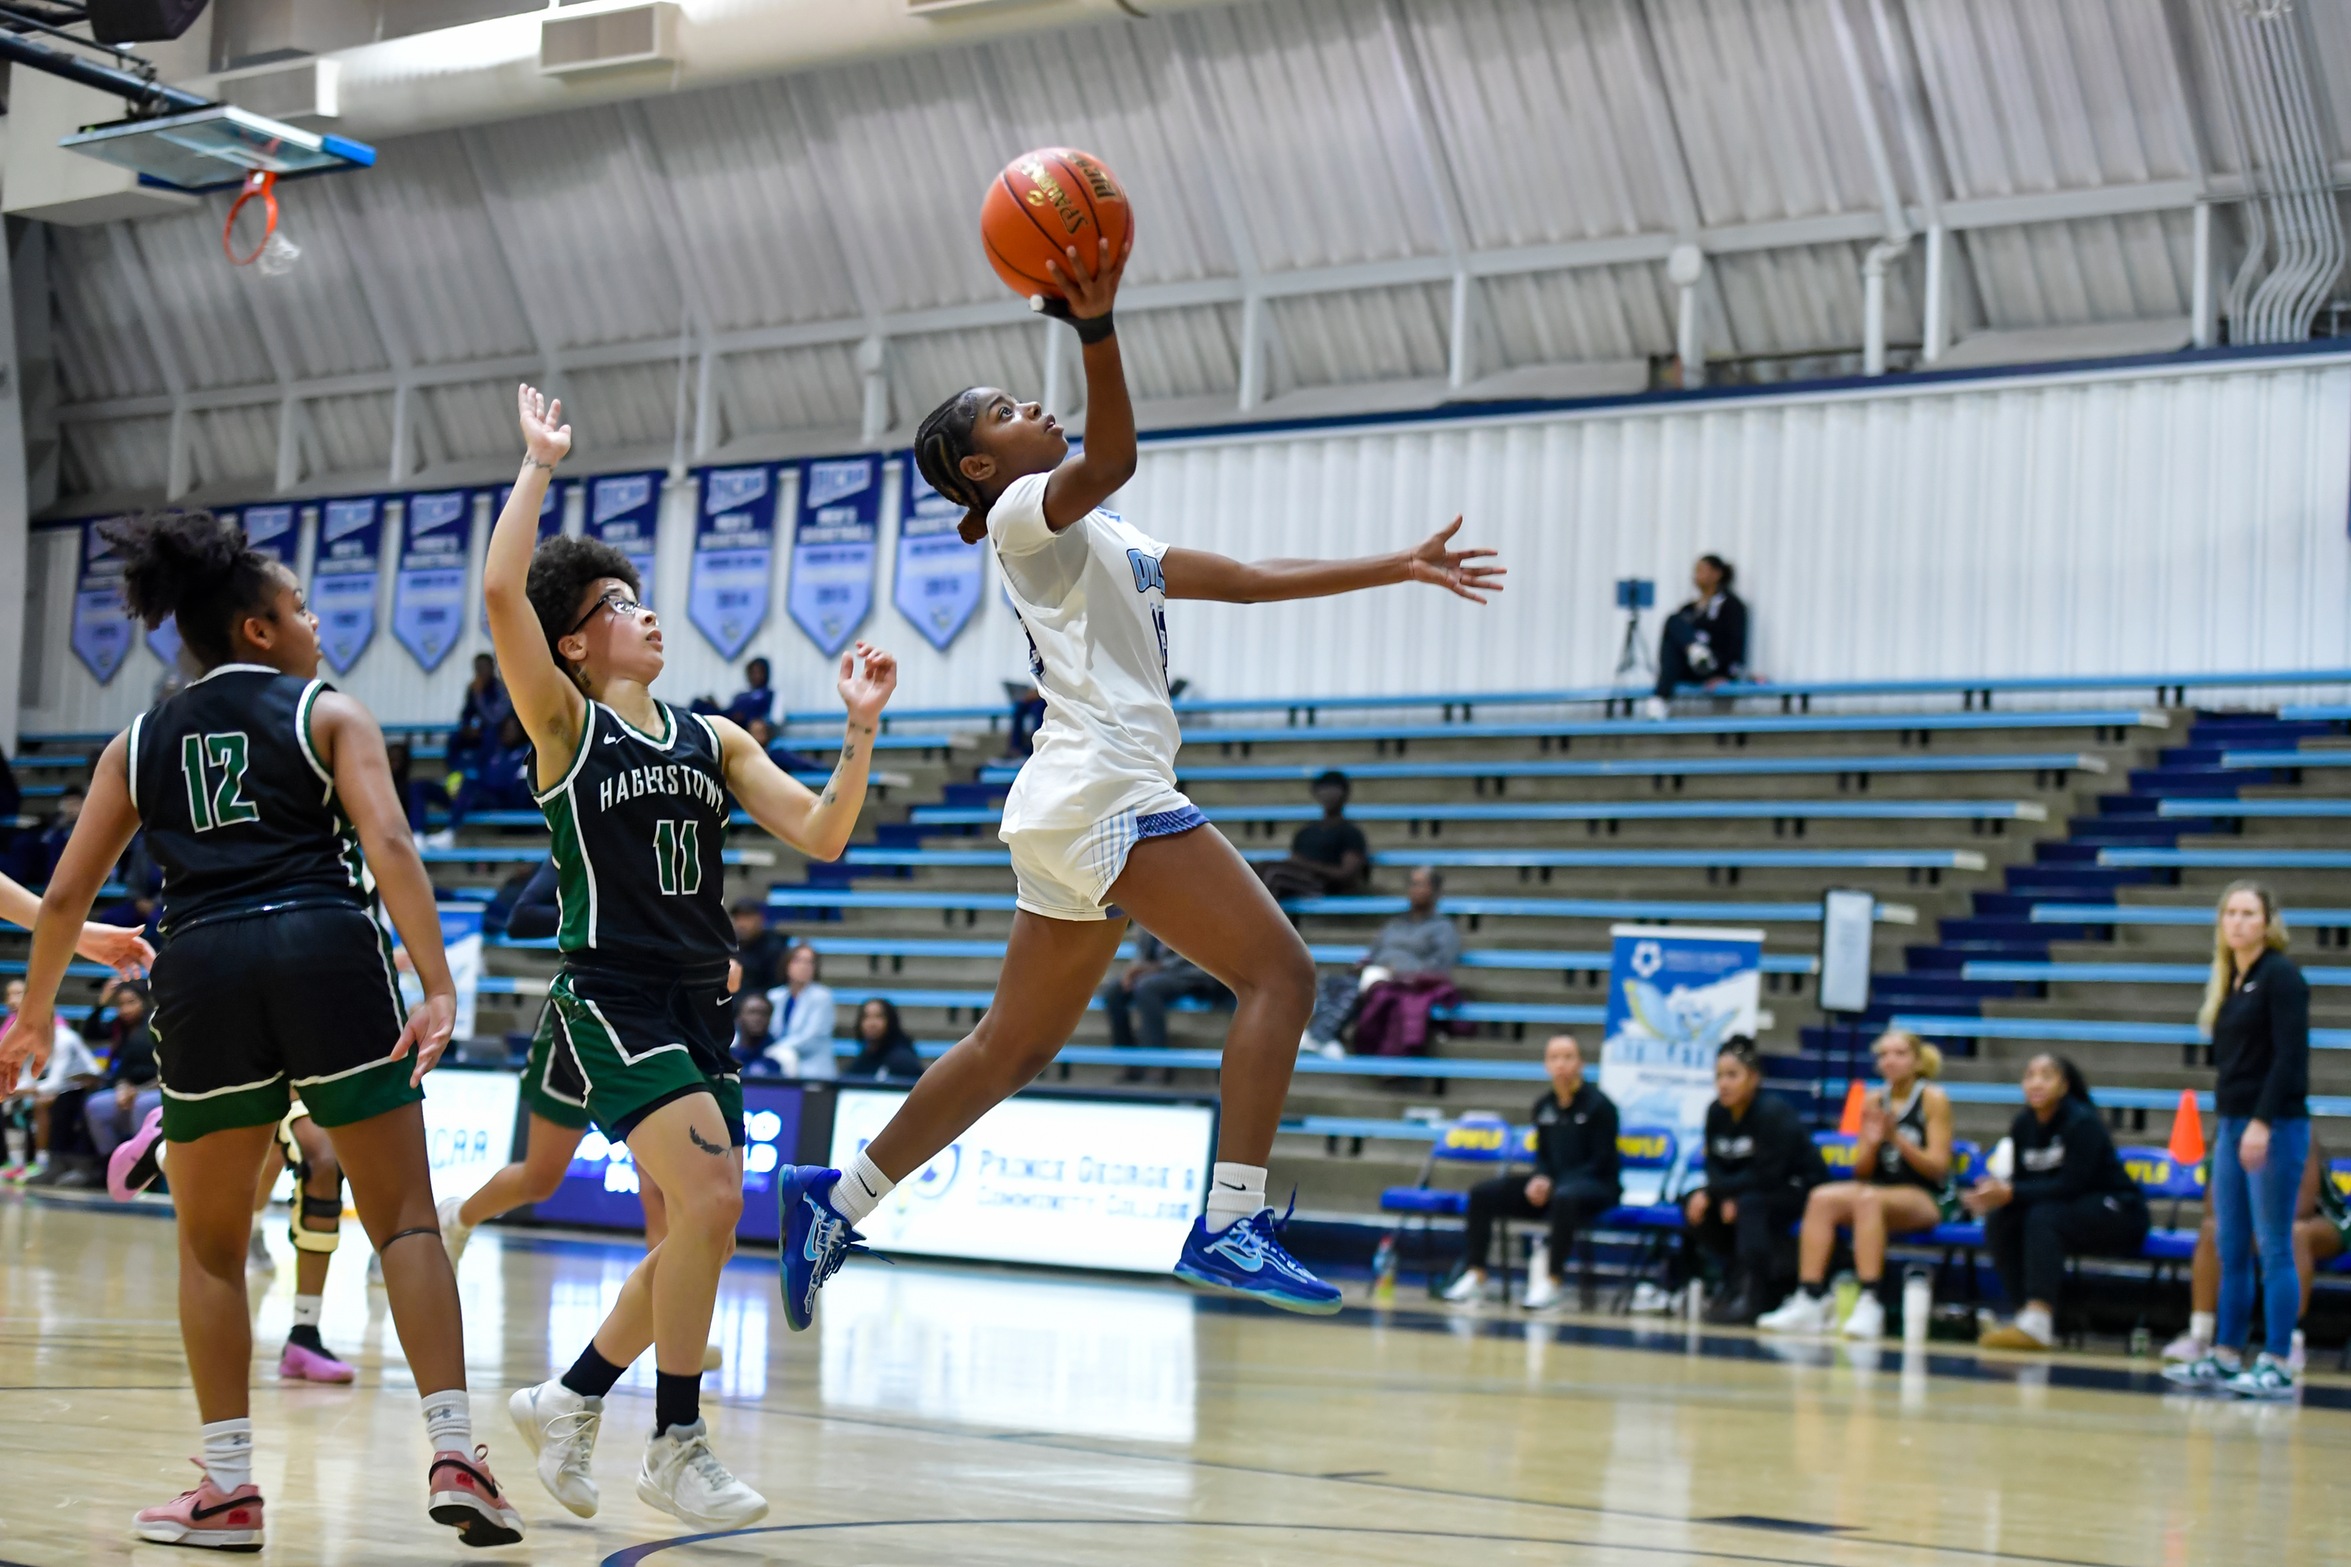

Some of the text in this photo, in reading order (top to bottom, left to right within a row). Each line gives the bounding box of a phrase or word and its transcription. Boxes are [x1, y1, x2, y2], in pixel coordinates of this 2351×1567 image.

[181, 731, 261, 834] 12
[652, 818, 702, 896] 11
[424, 1127, 489, 1170] CAA
